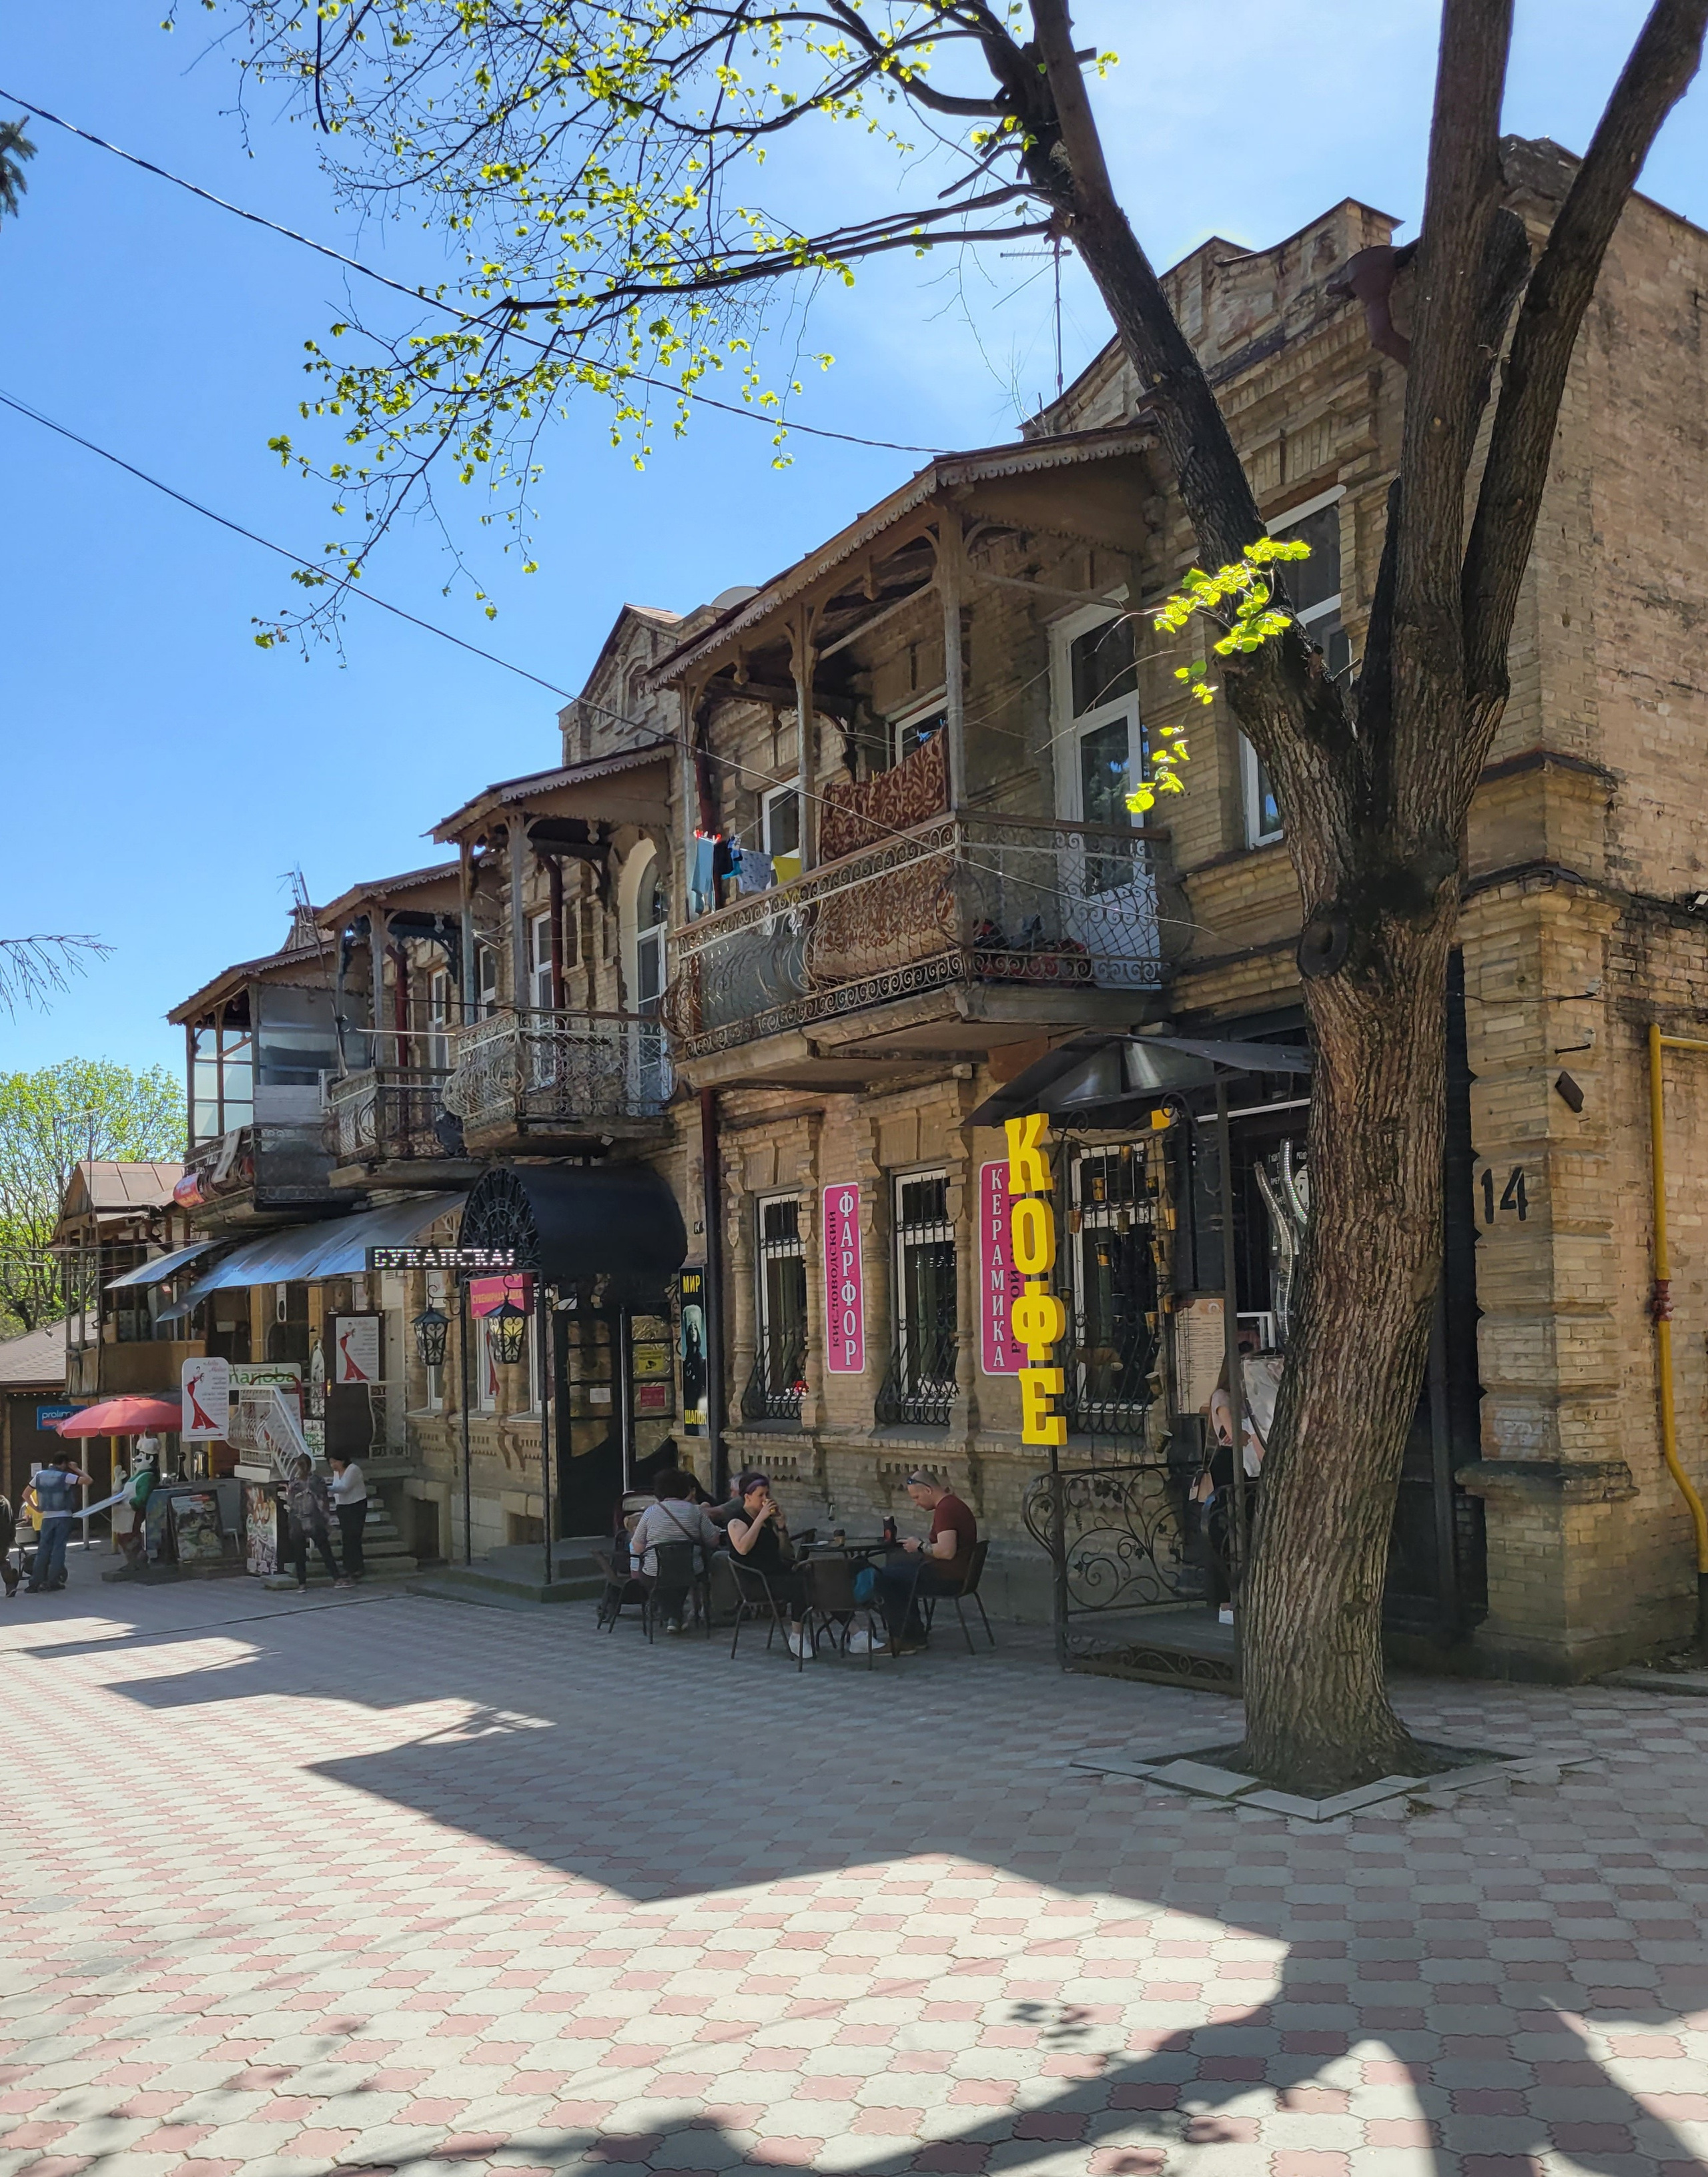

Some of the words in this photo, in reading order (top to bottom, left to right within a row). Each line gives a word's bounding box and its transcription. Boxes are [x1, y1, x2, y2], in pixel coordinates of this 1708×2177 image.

[1481, 1166, 1528, 1224] 14
[683, 1275, 701, 1294] МИР
[828, 1212, 840, 1348] КИСЛОВОДСКИЙ
[839, 1191, 857, 1366] ФАРФОР
[991, 1168, 1005, 1367] КЕРАМИКА
[1005, 1113, 1067, 1446] КОФЕ
[685, 1409, 707, 1425] ШАПОК
